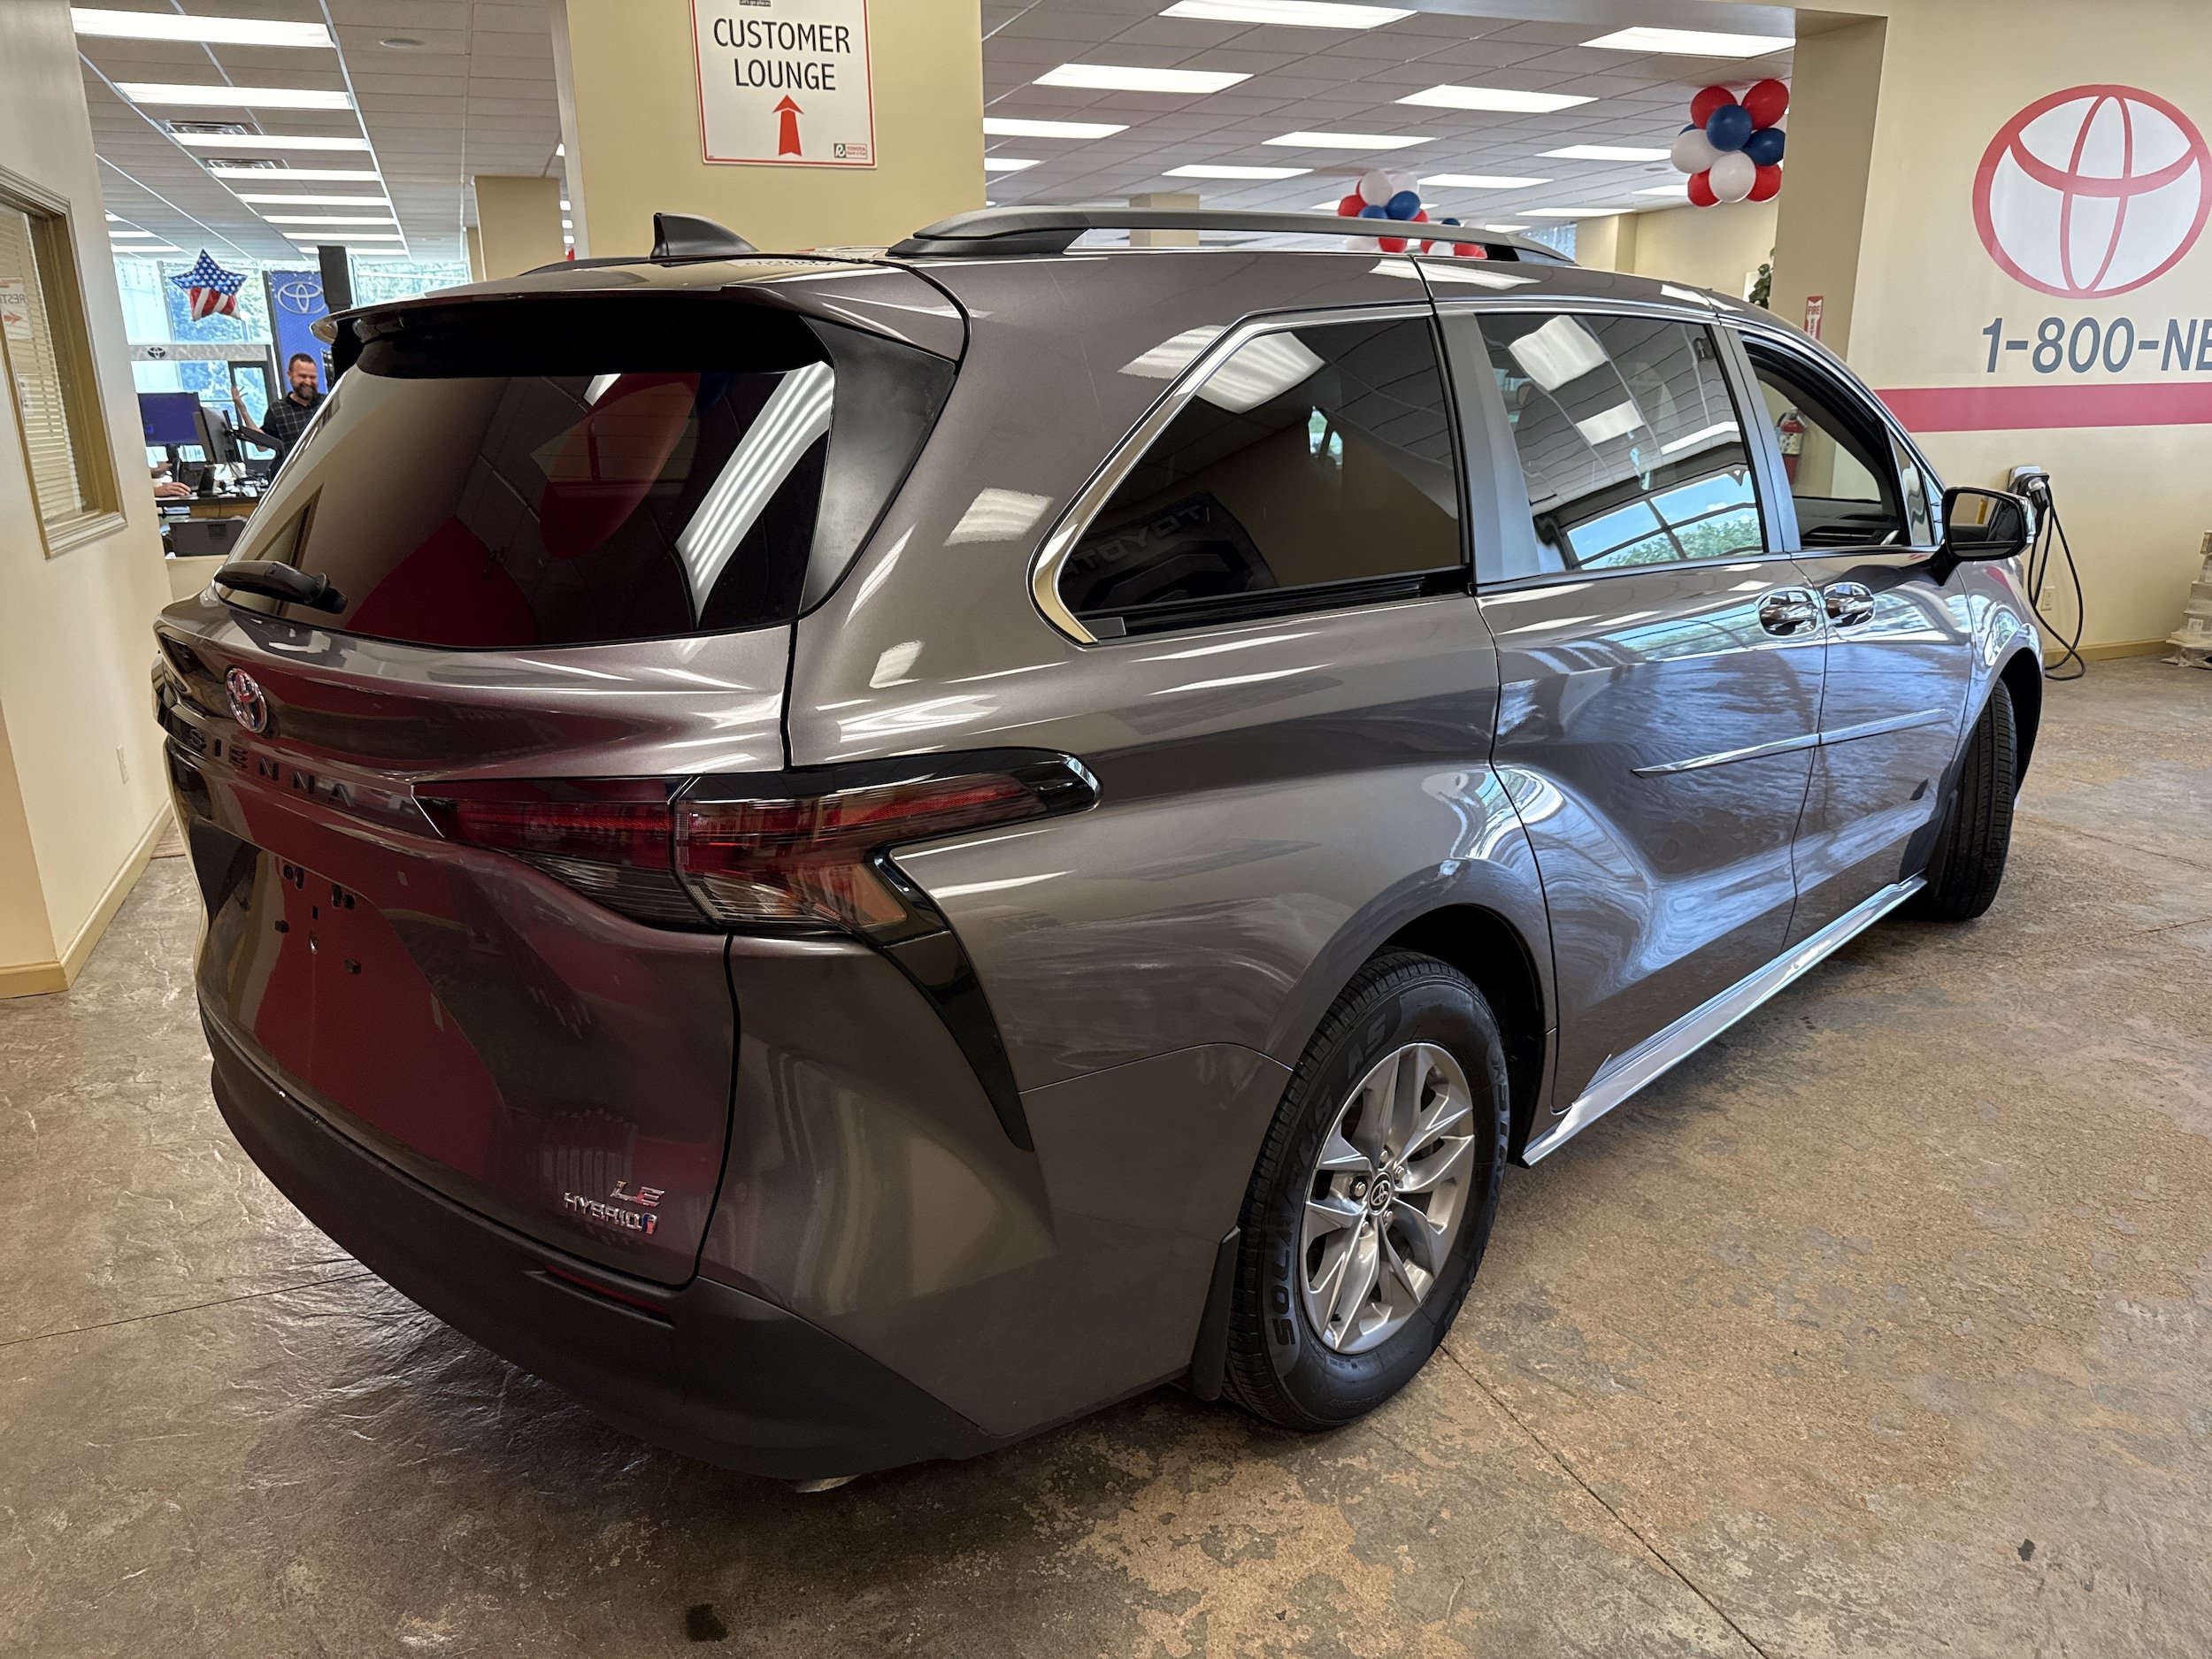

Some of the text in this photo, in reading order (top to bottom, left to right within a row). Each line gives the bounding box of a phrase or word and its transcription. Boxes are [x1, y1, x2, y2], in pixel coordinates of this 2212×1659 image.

[713, 18, 851, 54] CUSTOMER
[733, 58, 836, 90] LOUNGE
[1808, 305, 1821, 315] FIRE
[1982, 317, 2212, 373] 1-800-NE
[188, 728, 356, 807] SIENNA
[564, 1192, 643, 1232] HYBRID
[610, 1180, 665, 1208] LE
